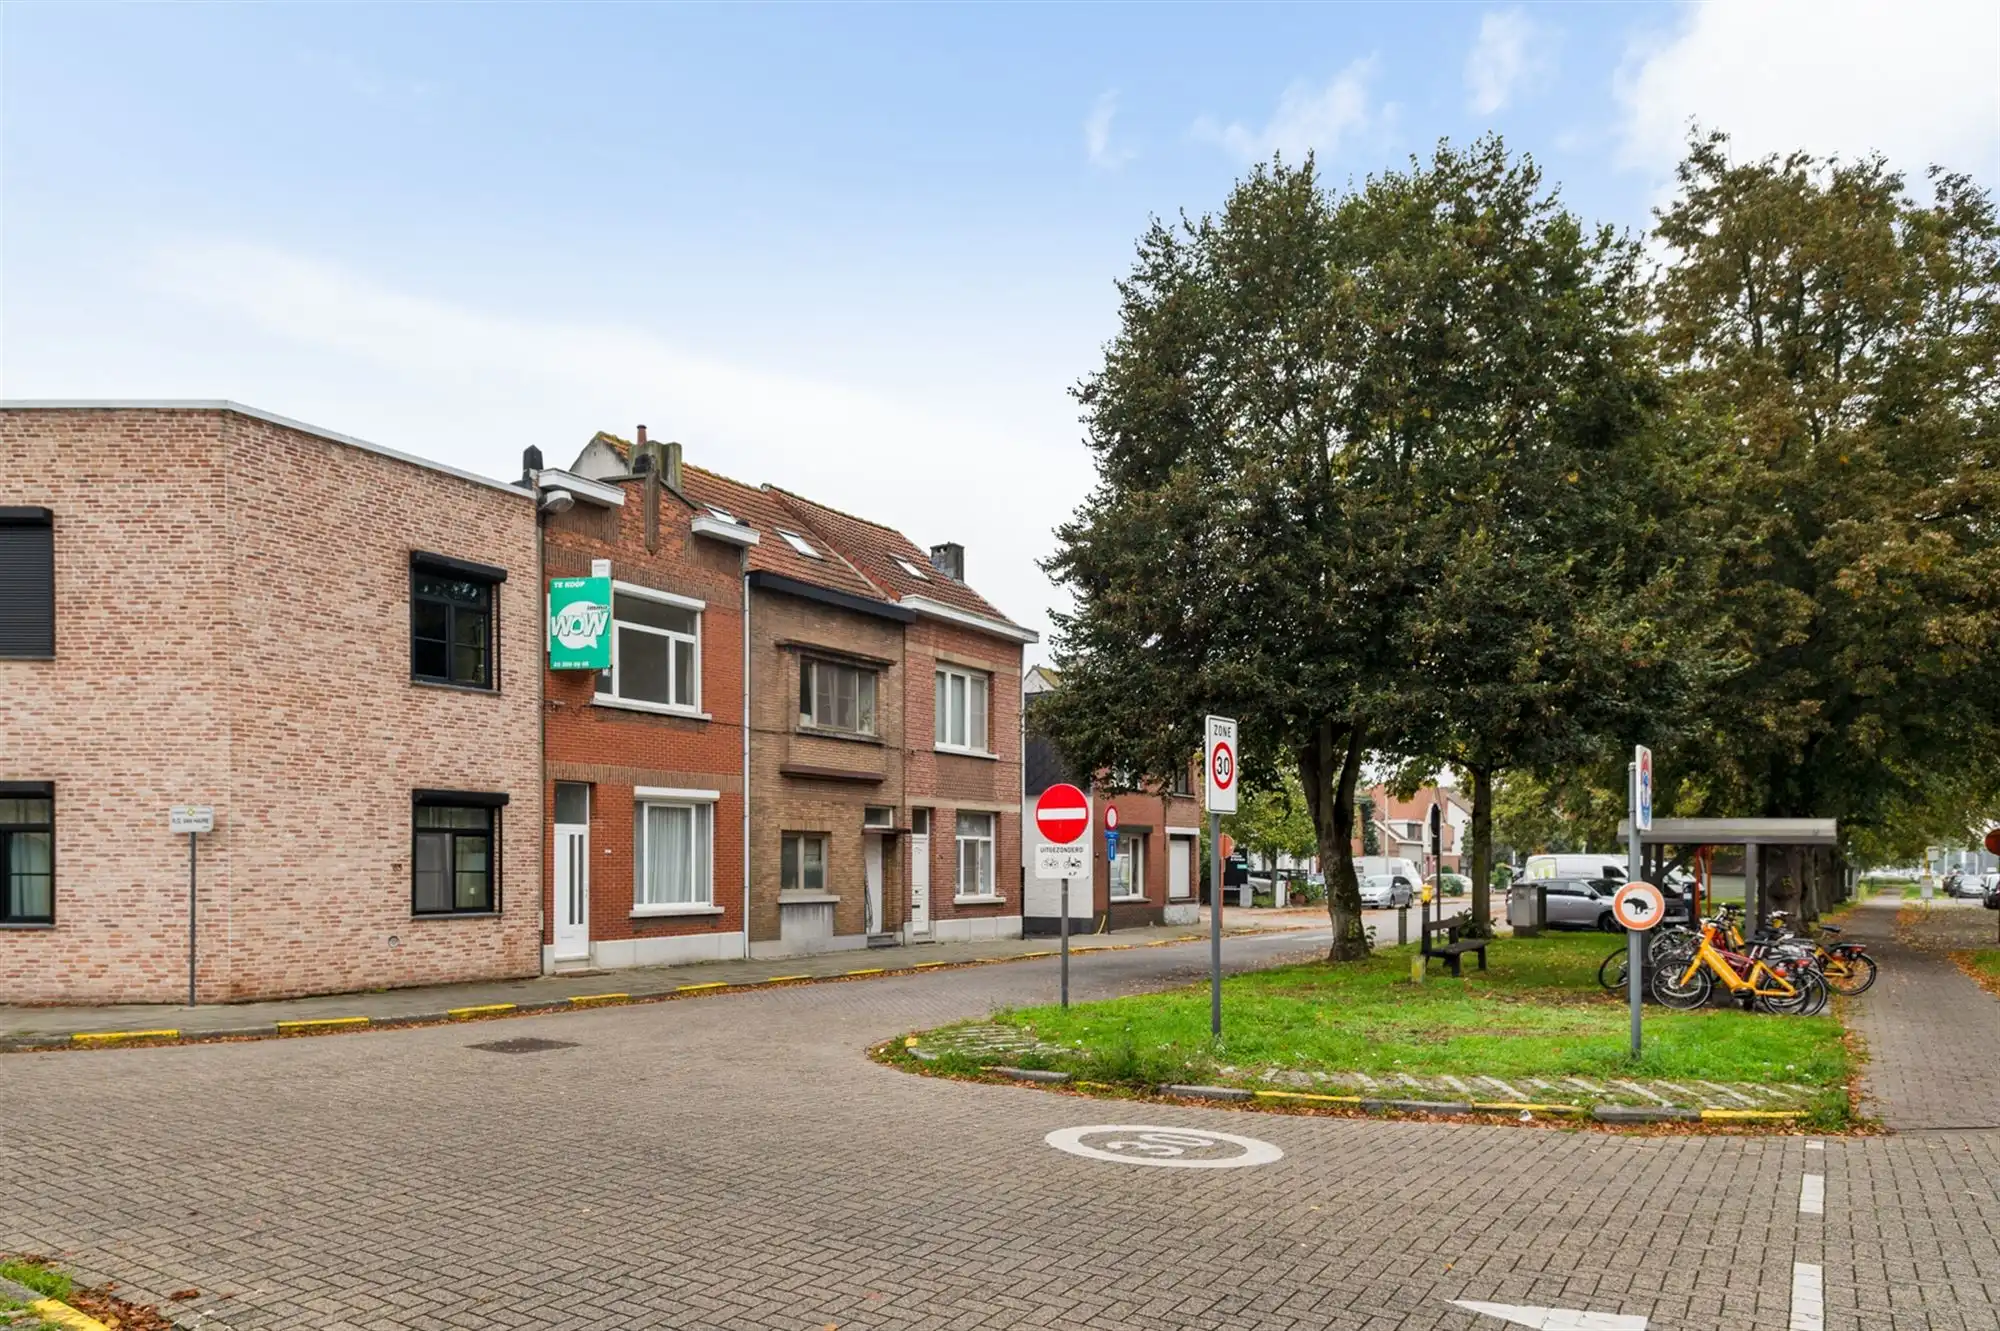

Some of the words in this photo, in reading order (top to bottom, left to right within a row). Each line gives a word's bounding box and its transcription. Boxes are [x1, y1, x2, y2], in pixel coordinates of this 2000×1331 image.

[551, 611, 609, 637] WOW
[1213, 724, 1232, 738] ZONE
[1216, 755, 1230, 776] 30
